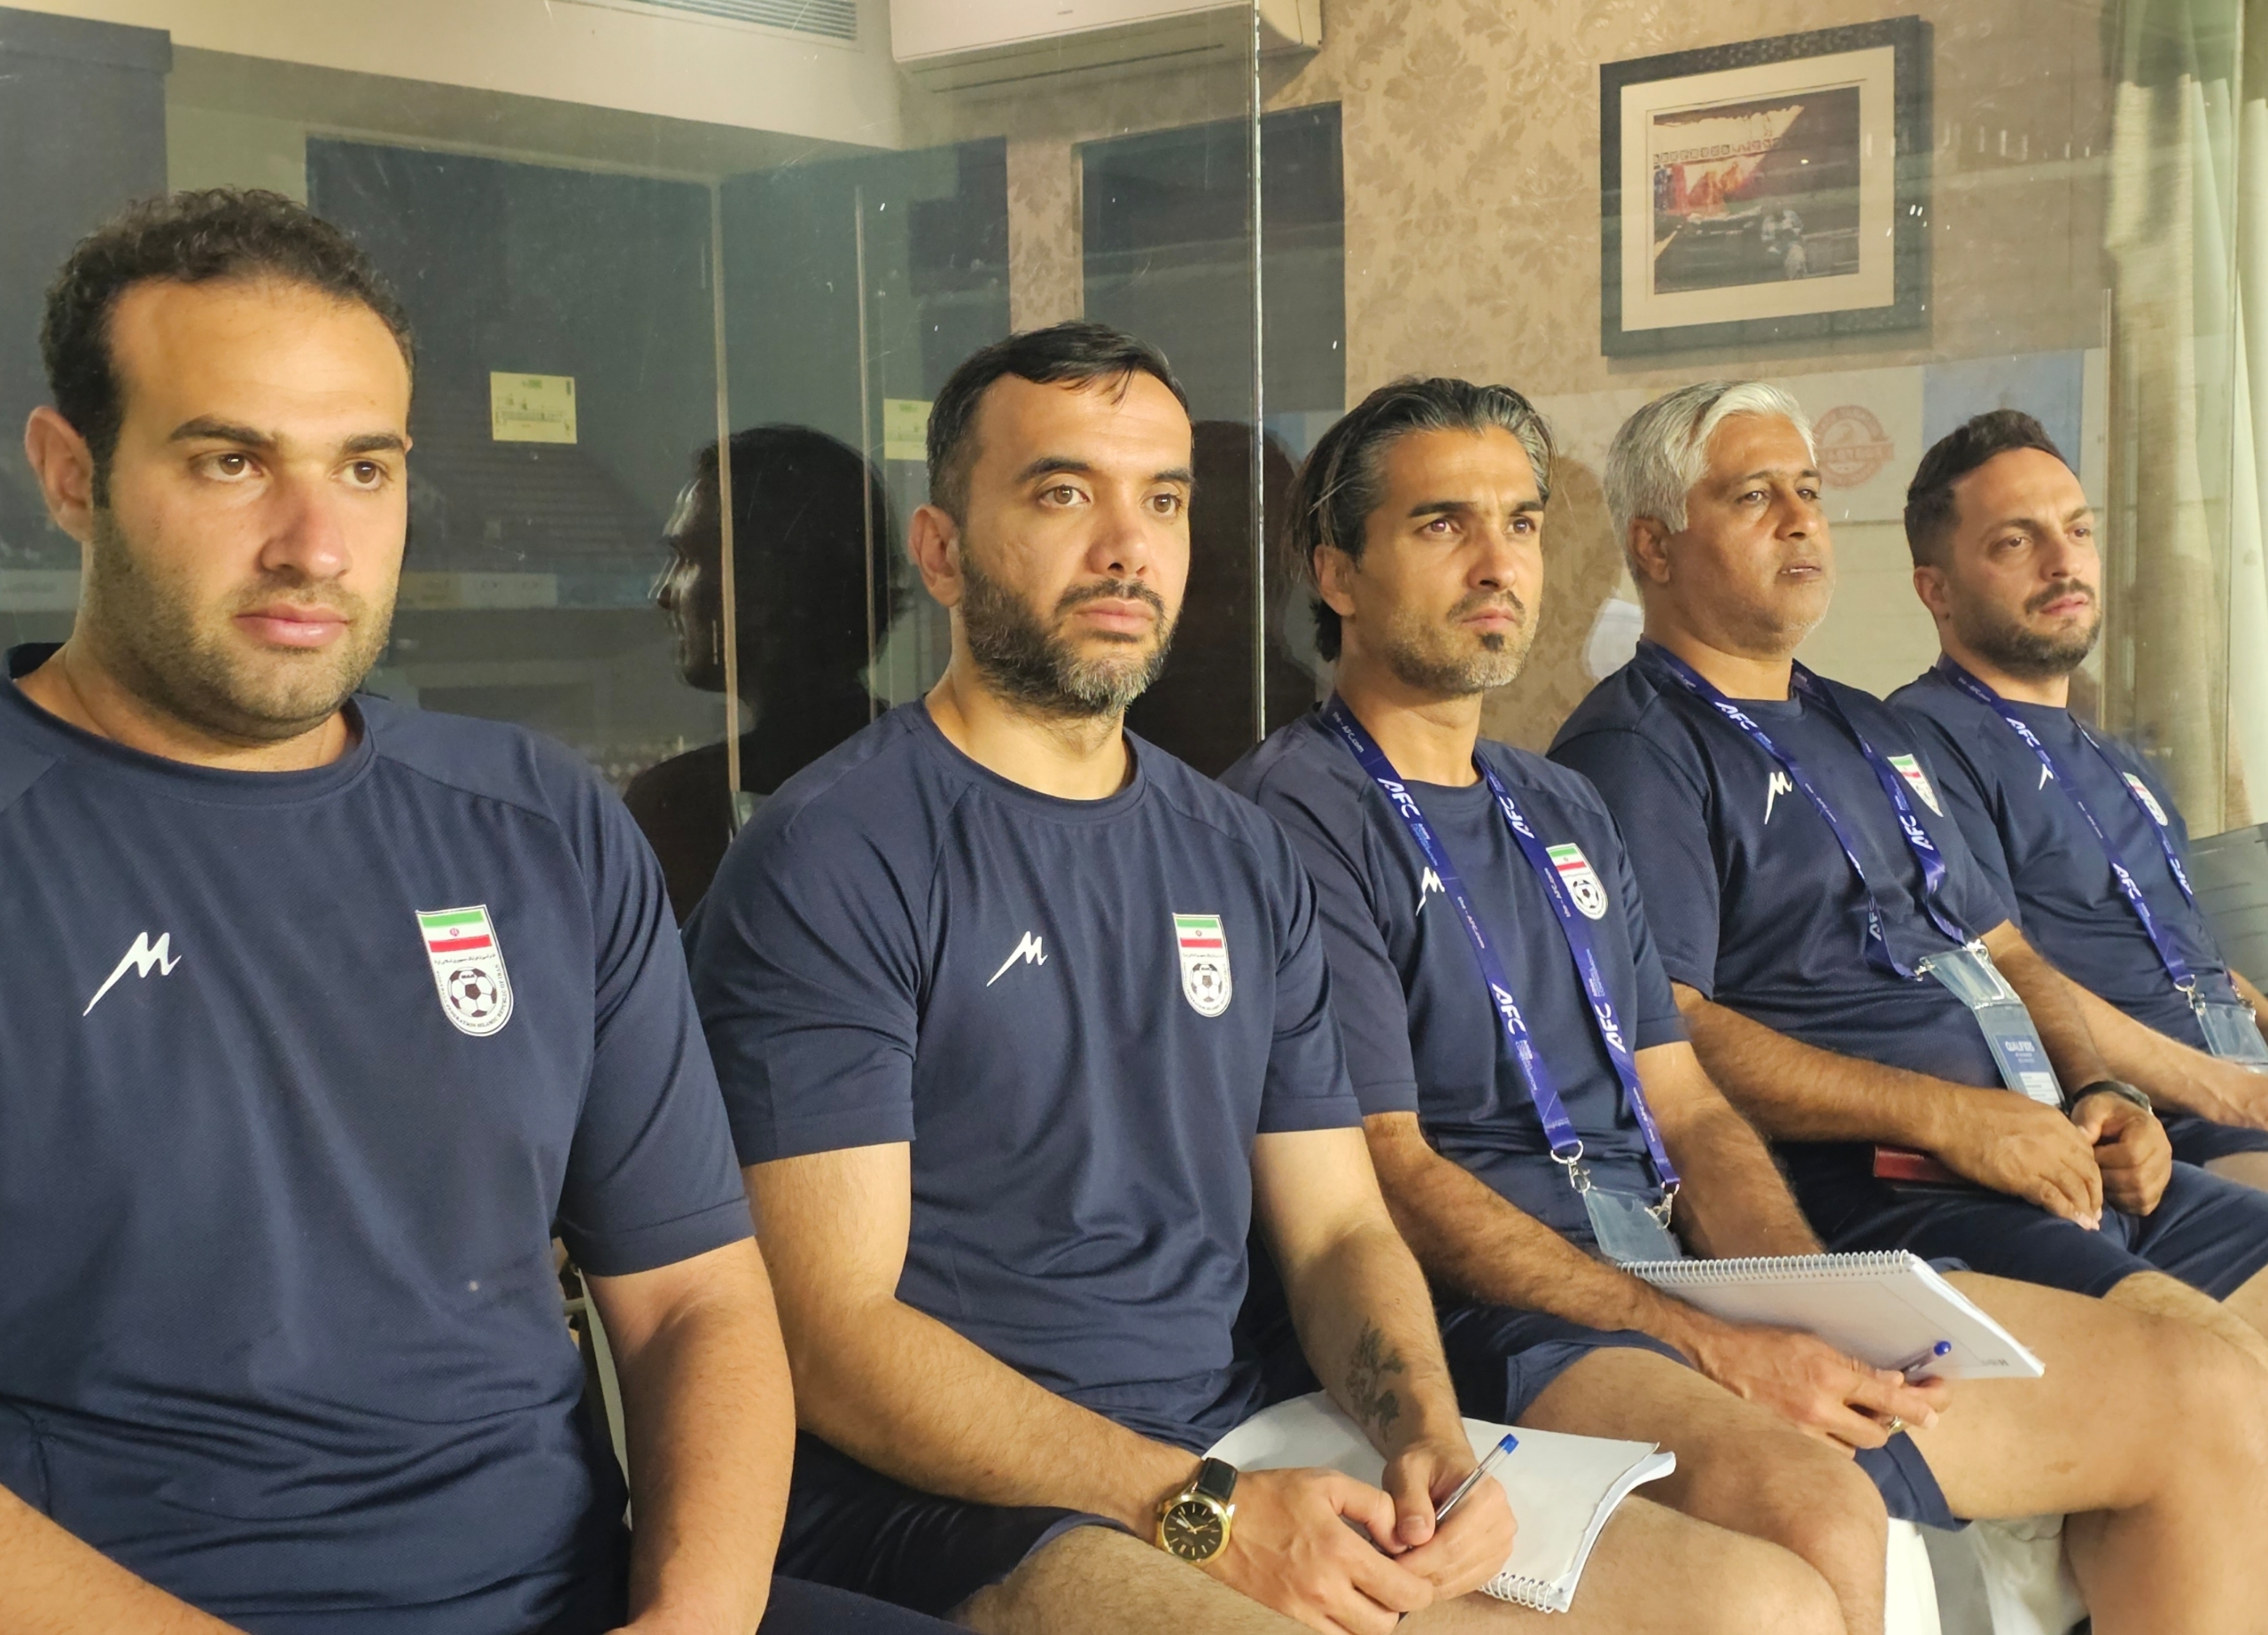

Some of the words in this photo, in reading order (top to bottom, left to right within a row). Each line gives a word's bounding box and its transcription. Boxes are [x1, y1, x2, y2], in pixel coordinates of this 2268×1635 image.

[1714, 702, 1759, 730] AFC
[2006, 717, 2041, 747] AFC
[1377, 777, 1421, 818] AFC
[1499, 795, 1534, 838] AFC
[1899, 815, 1934, 851] AFC
[2112, 863, 2142, 899] AFC
[1868, 896, 1882, 941] AFC
[1492, 983, 1526, 1035] AFC
[1595, 1002, 1626, 1054] AFC
